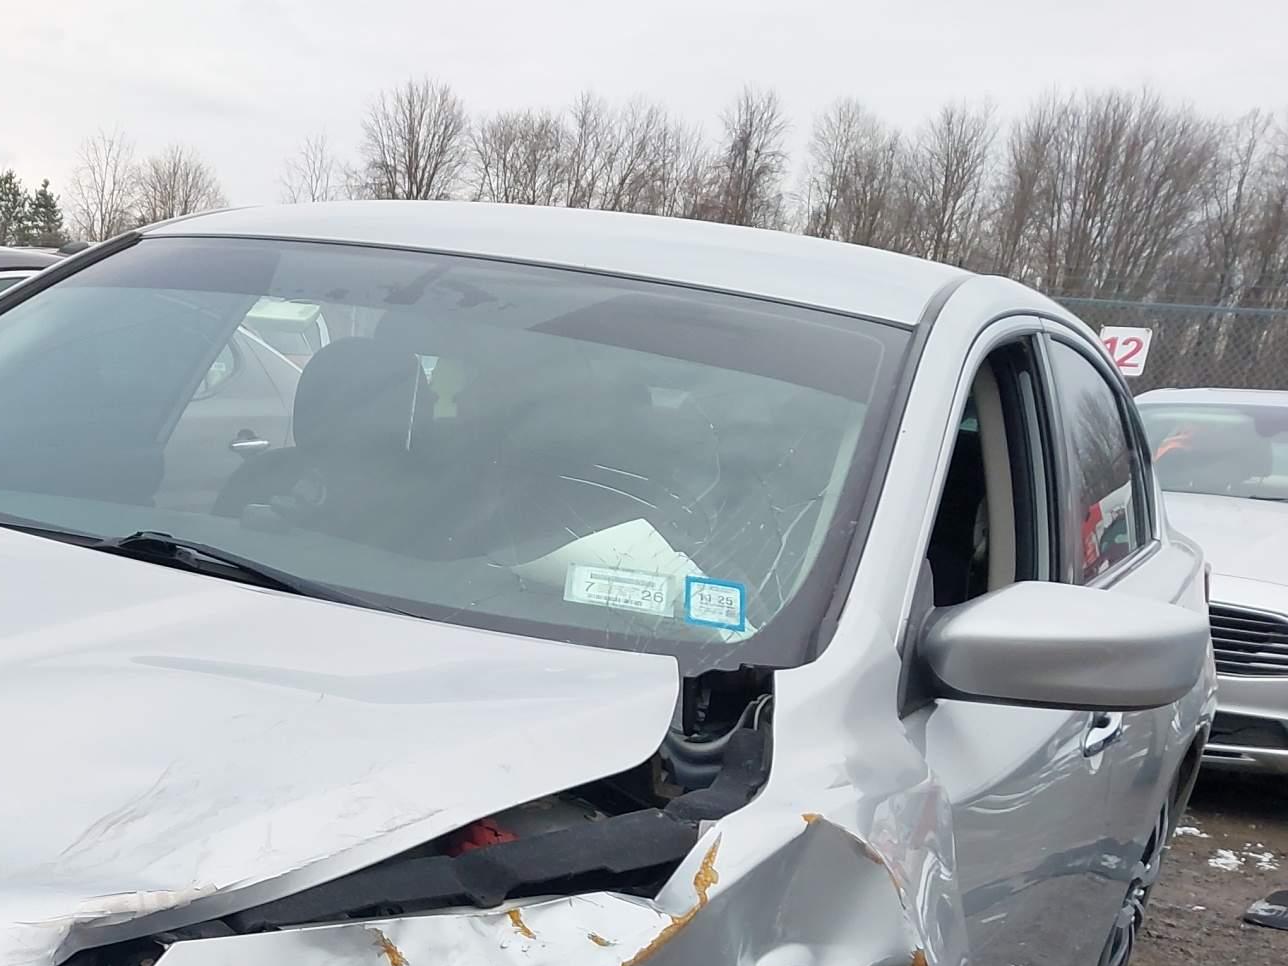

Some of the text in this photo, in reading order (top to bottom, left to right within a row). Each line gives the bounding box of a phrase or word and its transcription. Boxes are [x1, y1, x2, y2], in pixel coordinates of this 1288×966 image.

[1103, 336, 1145, 368] 12
[584, 580, 596, 593] 7
[641, 589, 665, 604] 26
